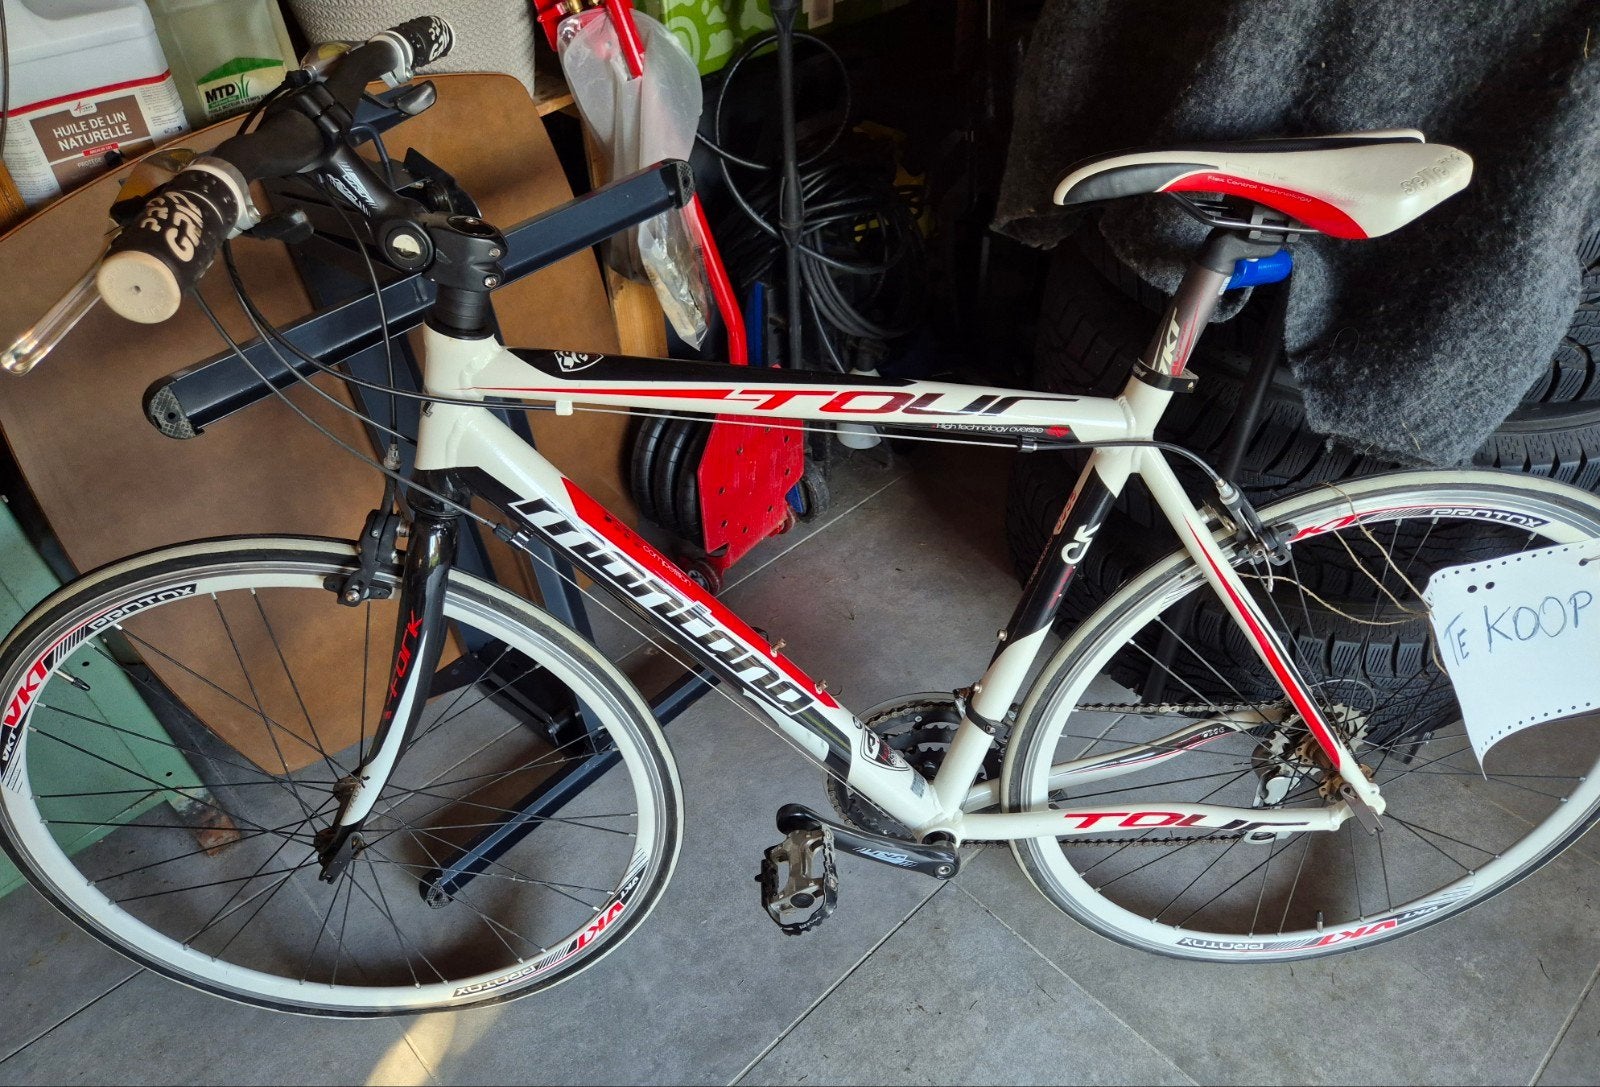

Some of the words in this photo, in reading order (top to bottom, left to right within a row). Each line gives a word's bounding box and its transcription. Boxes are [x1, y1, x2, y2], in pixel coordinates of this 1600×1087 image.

[205, 83, 236, 104] MTD
[53, 120, 90, 139] HUILE
[88, 116, 107, 129] DE
[108, 111, 127, 126] LIN
[58, 122, 133, 152] NATURELLE
[1207, 175, 1225, 183] Flex
[1226, 178, 1259, 190] Control
[1260, 185, 1312, 204] Technology
[738, 389, 1079, 416] TOUR
[936, 423, 957, 432] High
[958, 423, 1009, 433] technology
[1429, 508, 1546, 528] PROTOX
[642, 545, 692, 587] competition
[88, 584, 195, 632] PROTOX
[1443, 611, 1471, 667] TE
[1482, 589, 1594, 653] KOOP
[3, 657, 51, 728] VKT
[1064, 811, 1311, 831] TOUR
[577, 900, 625, 950] VKT
[1317, 919, 1397, 947] VKT
[1181, 938, 1265, 950] PROTOX
